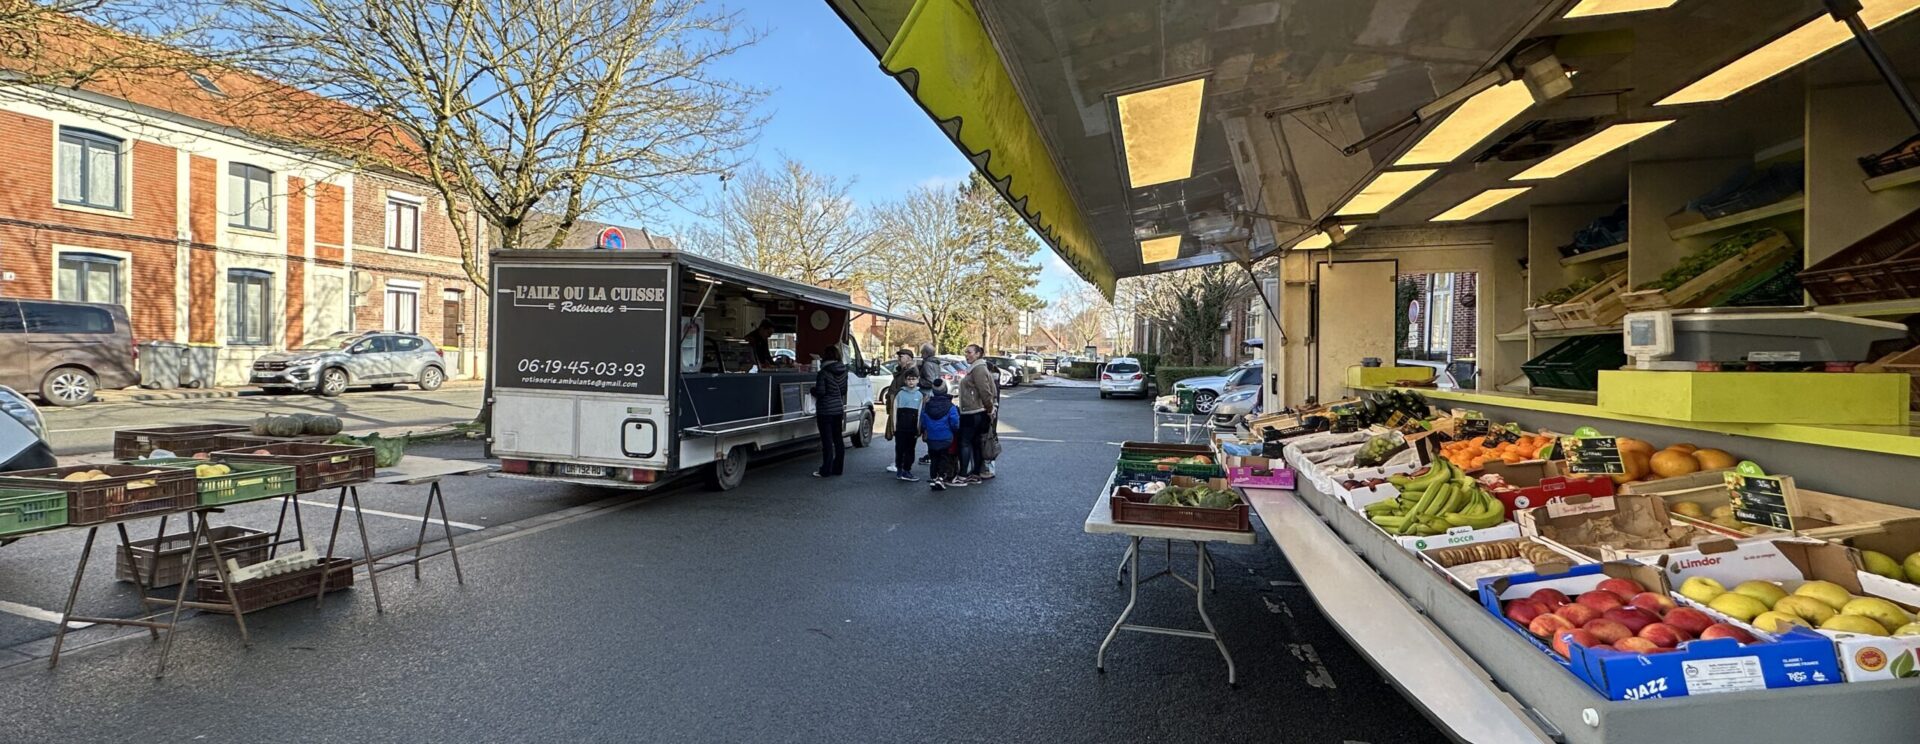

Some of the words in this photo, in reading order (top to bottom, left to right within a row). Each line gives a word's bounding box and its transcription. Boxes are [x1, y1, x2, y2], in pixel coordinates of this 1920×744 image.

[516, 285, 560, 300] L'AILE
[563, 286, 584, 300] OU
[588, 287, 607, 301] LA
[610, 287, 665, 302] CUISSE
[560, 301, 615, 314] Rotisserie
[521, 376, 639, 388] rotisserie.ambulante@gmail.com
[1680, 556, 1722, 569] Limdor
[1634, 677, 1668, 701] JAZZ
